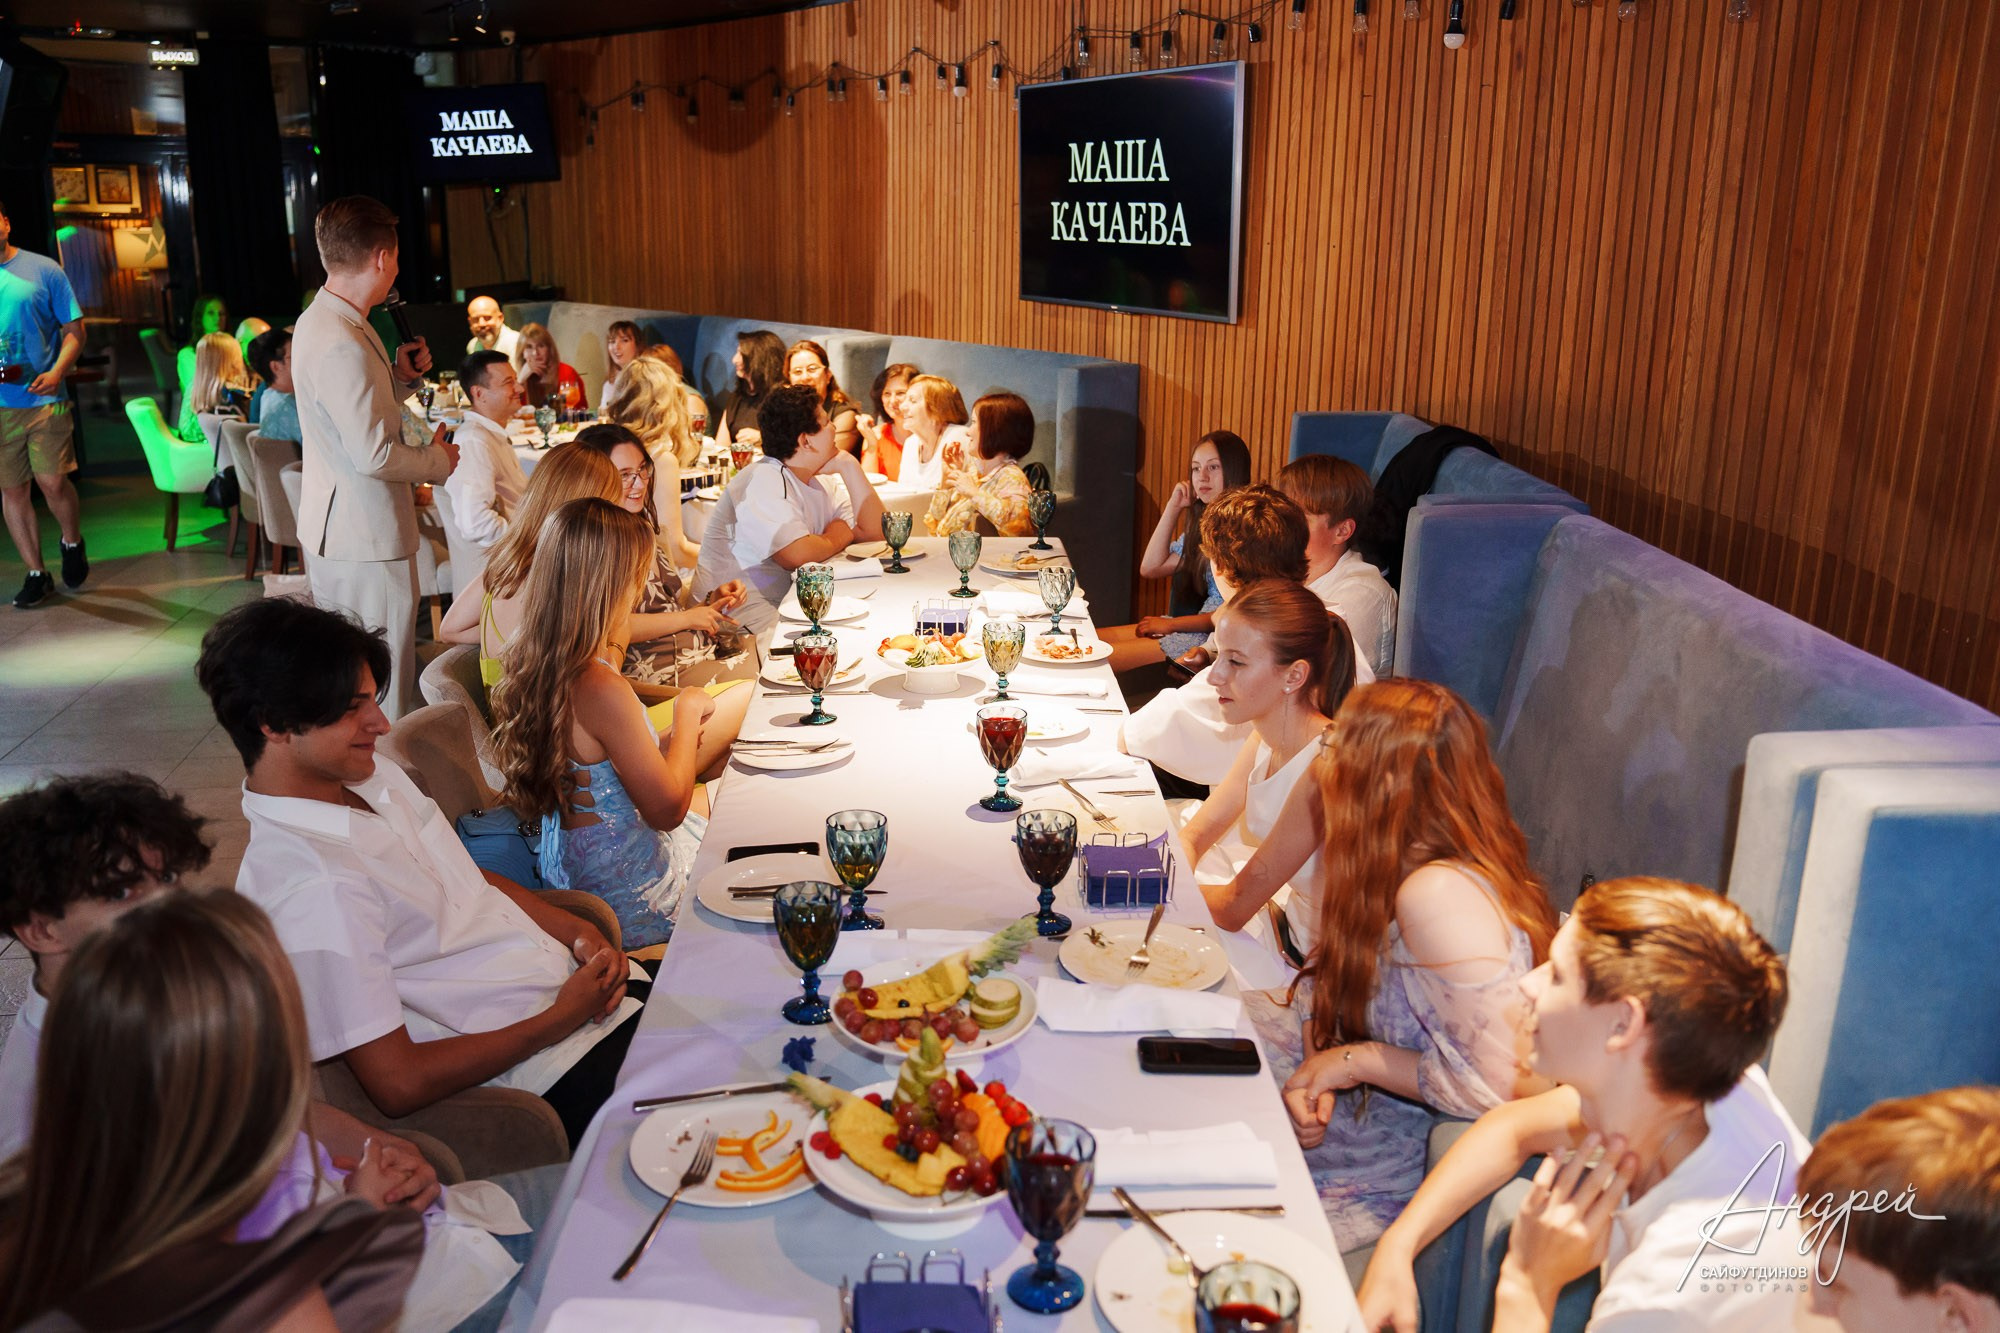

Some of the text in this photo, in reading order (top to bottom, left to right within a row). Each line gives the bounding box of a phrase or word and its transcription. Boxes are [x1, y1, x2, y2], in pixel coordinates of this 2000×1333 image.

[151, 51, 195, 62] ВЫХОД
[439, 109, 514, 131] МАША
[430, 134, 533, 157] КАЧАЕВА
[1068, 138, 1170, 183] МАША
[1050, 201, 1192, 247] КАЧАЕВА
